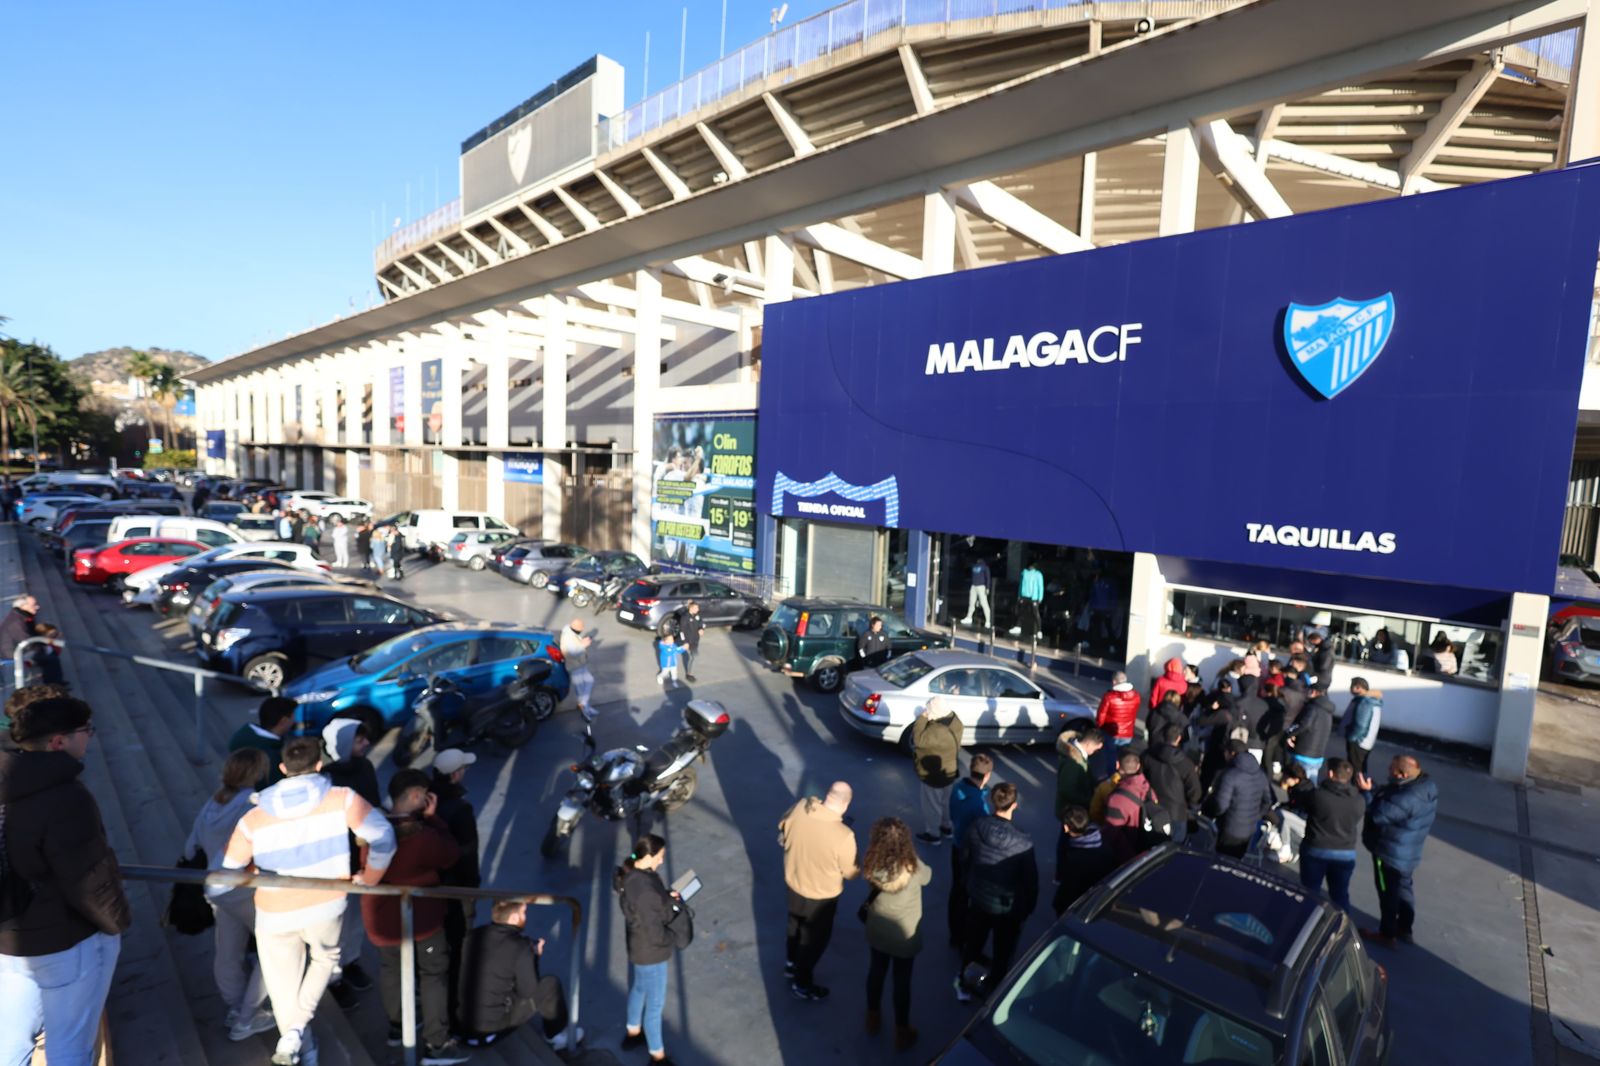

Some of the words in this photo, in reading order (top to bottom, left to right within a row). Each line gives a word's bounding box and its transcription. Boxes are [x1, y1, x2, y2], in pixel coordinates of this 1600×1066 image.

[713, 433, 737, 450] Olin
[711, 454, 753, 477] FOROFOS
[797, 501, 829, 515] TIENDA
[830, 504, 866, 518] OFICIAL
[1246, 523, 1396, 554] TAQUILLAS
